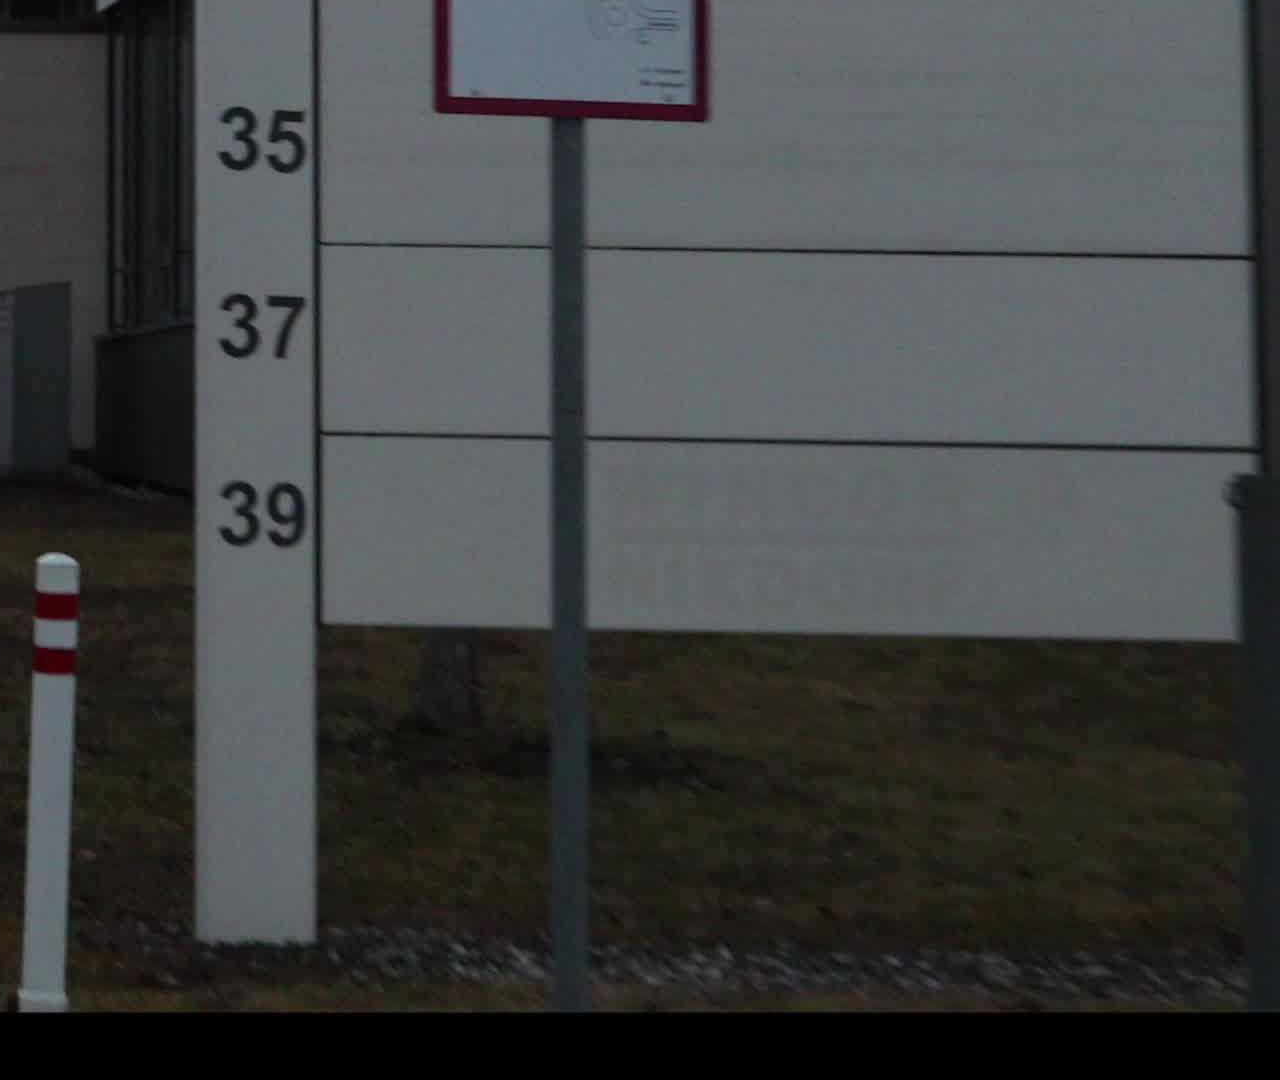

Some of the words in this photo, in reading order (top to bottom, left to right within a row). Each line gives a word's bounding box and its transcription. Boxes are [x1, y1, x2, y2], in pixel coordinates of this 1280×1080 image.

[217, 106, 306, 174] 35
[218, 293, 306, 358] 37
[218, 481, 306, 548] 39
